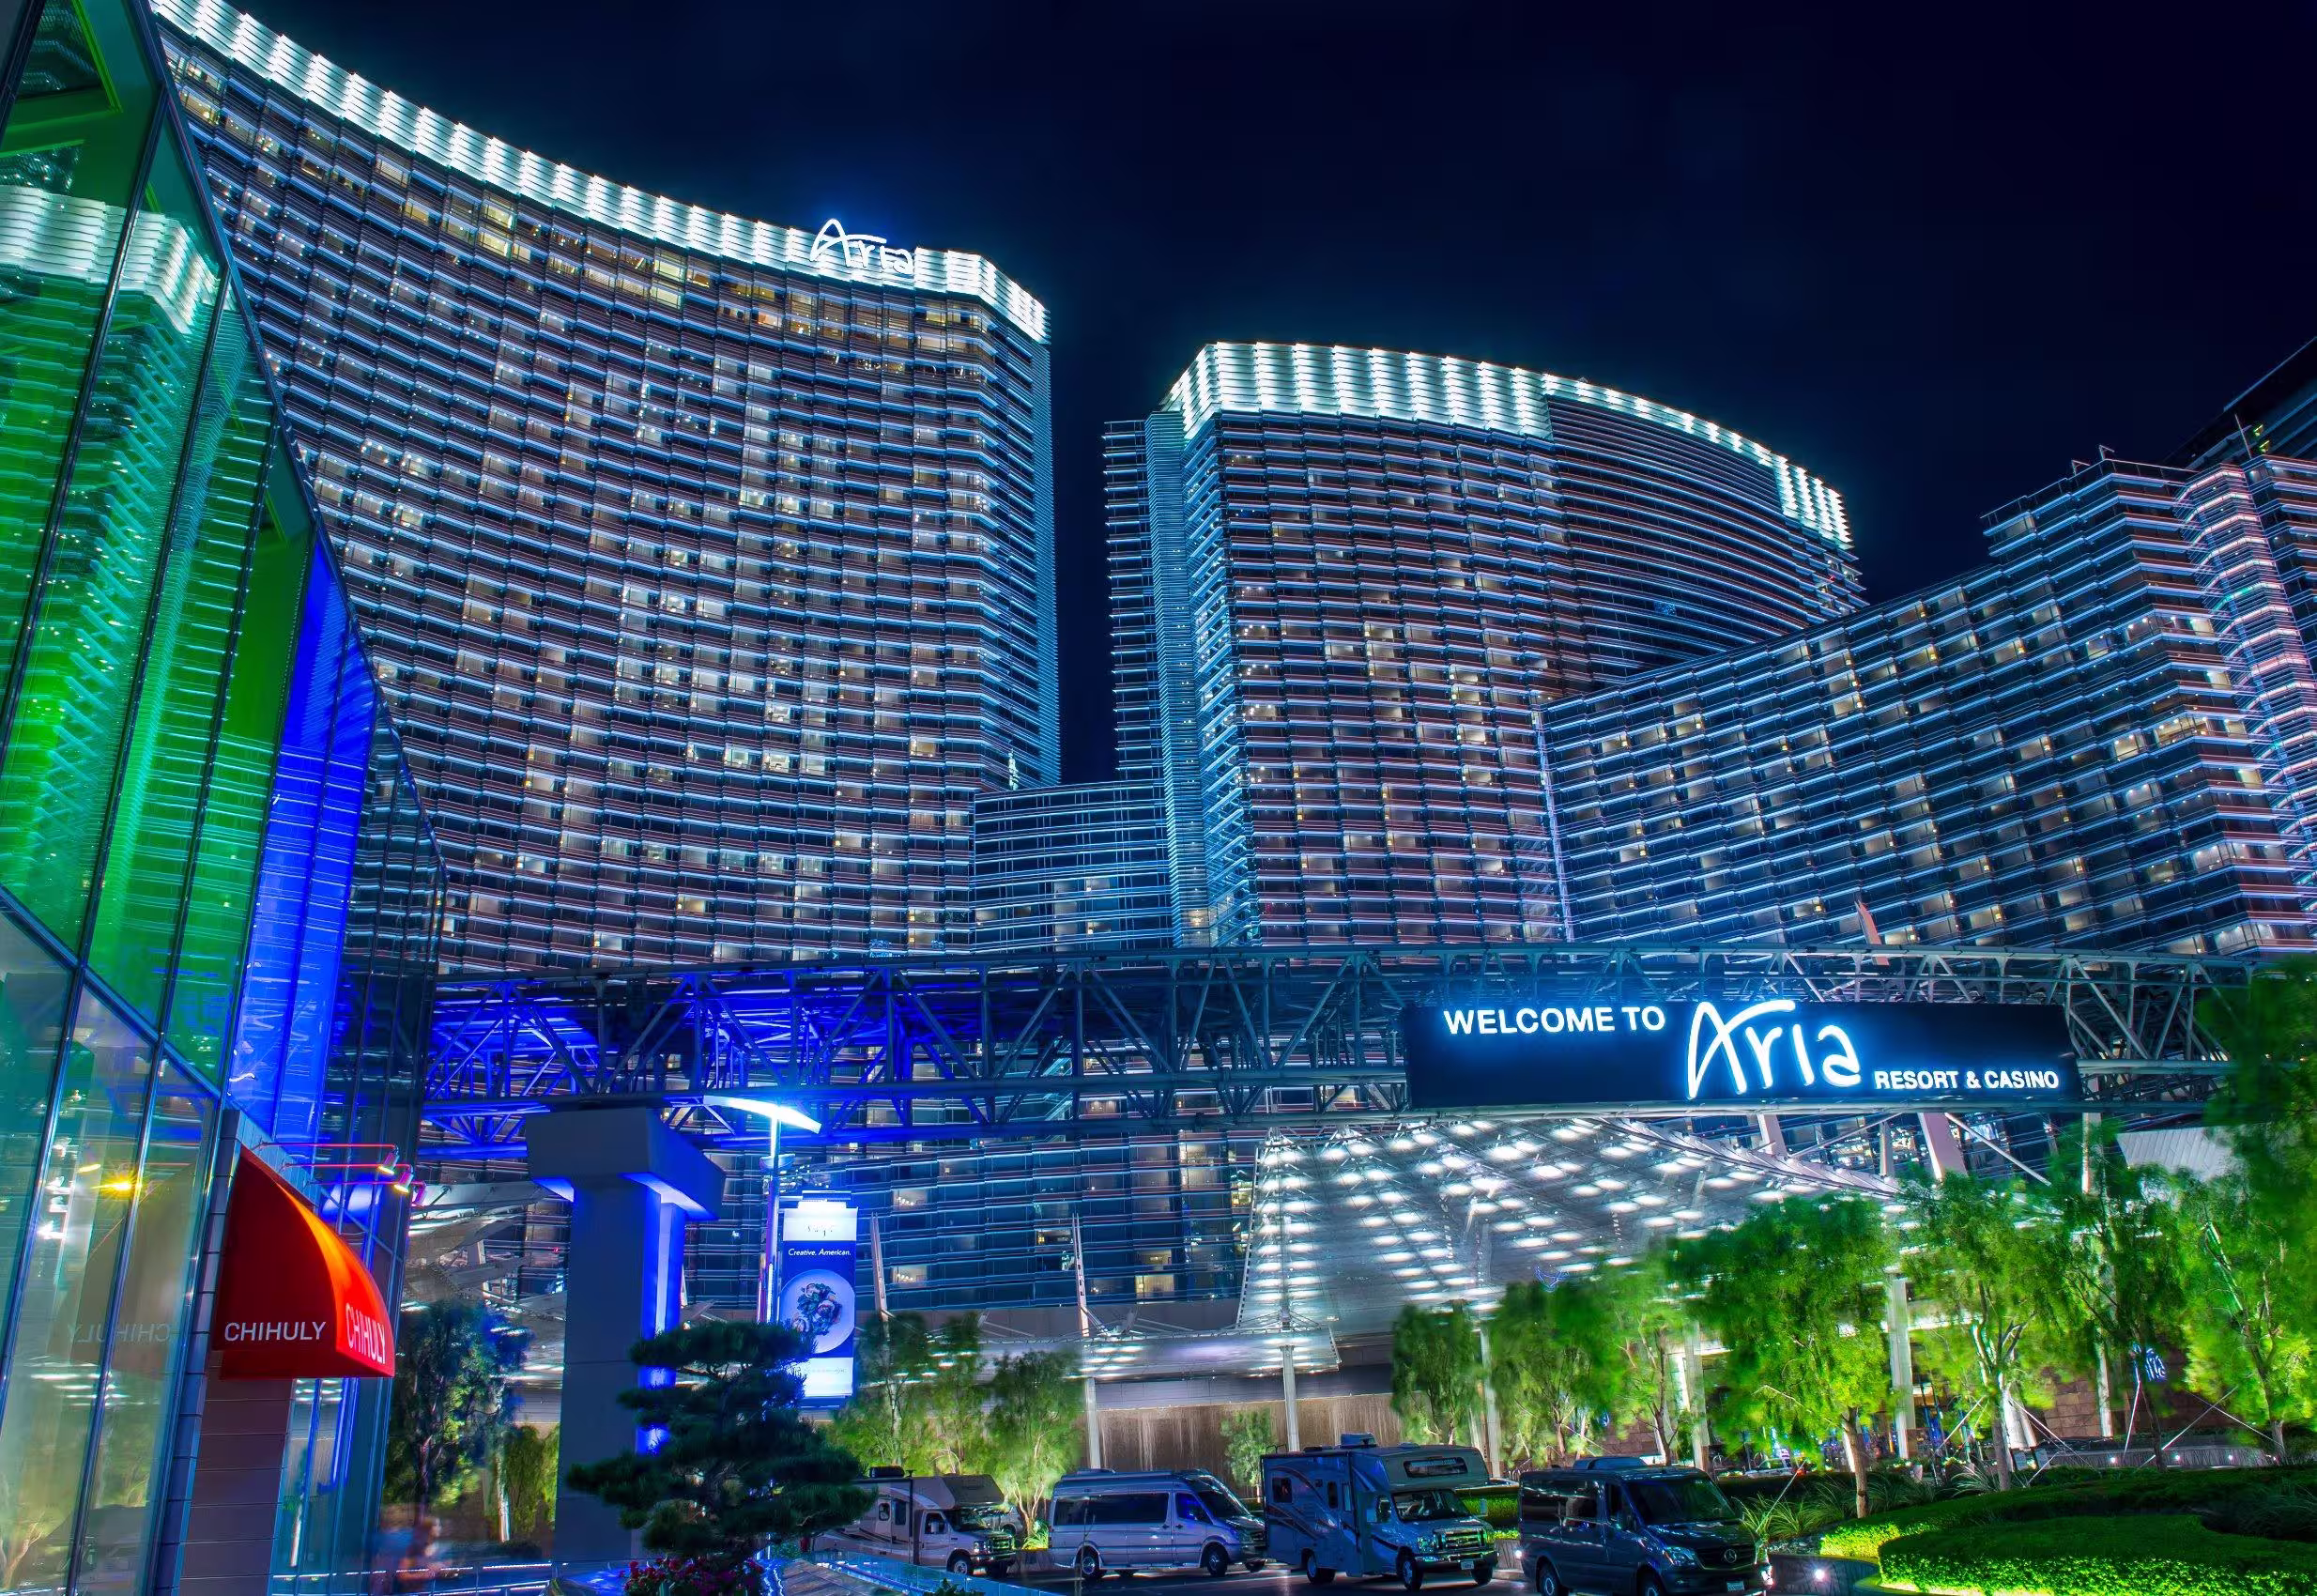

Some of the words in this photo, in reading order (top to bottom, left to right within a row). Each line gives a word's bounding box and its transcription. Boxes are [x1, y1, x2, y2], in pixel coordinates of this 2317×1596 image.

[809, 218, 913, 276] Aria
[1443, 1006, 1616, 1035] WELCOME
[1623, 1005, 1666, 1032] TO
[1687, 999, 1863, 1099] Aria
[1874, 1070, 1959, 1090] RESORT
[1966, 1070, 1979, 1089] &
[1984, 1070, 2060, 1090] CASINO
[224, 1321, 327, 1342] CHIHULY
[345, 1302, 386, 1364] CHIHULY
